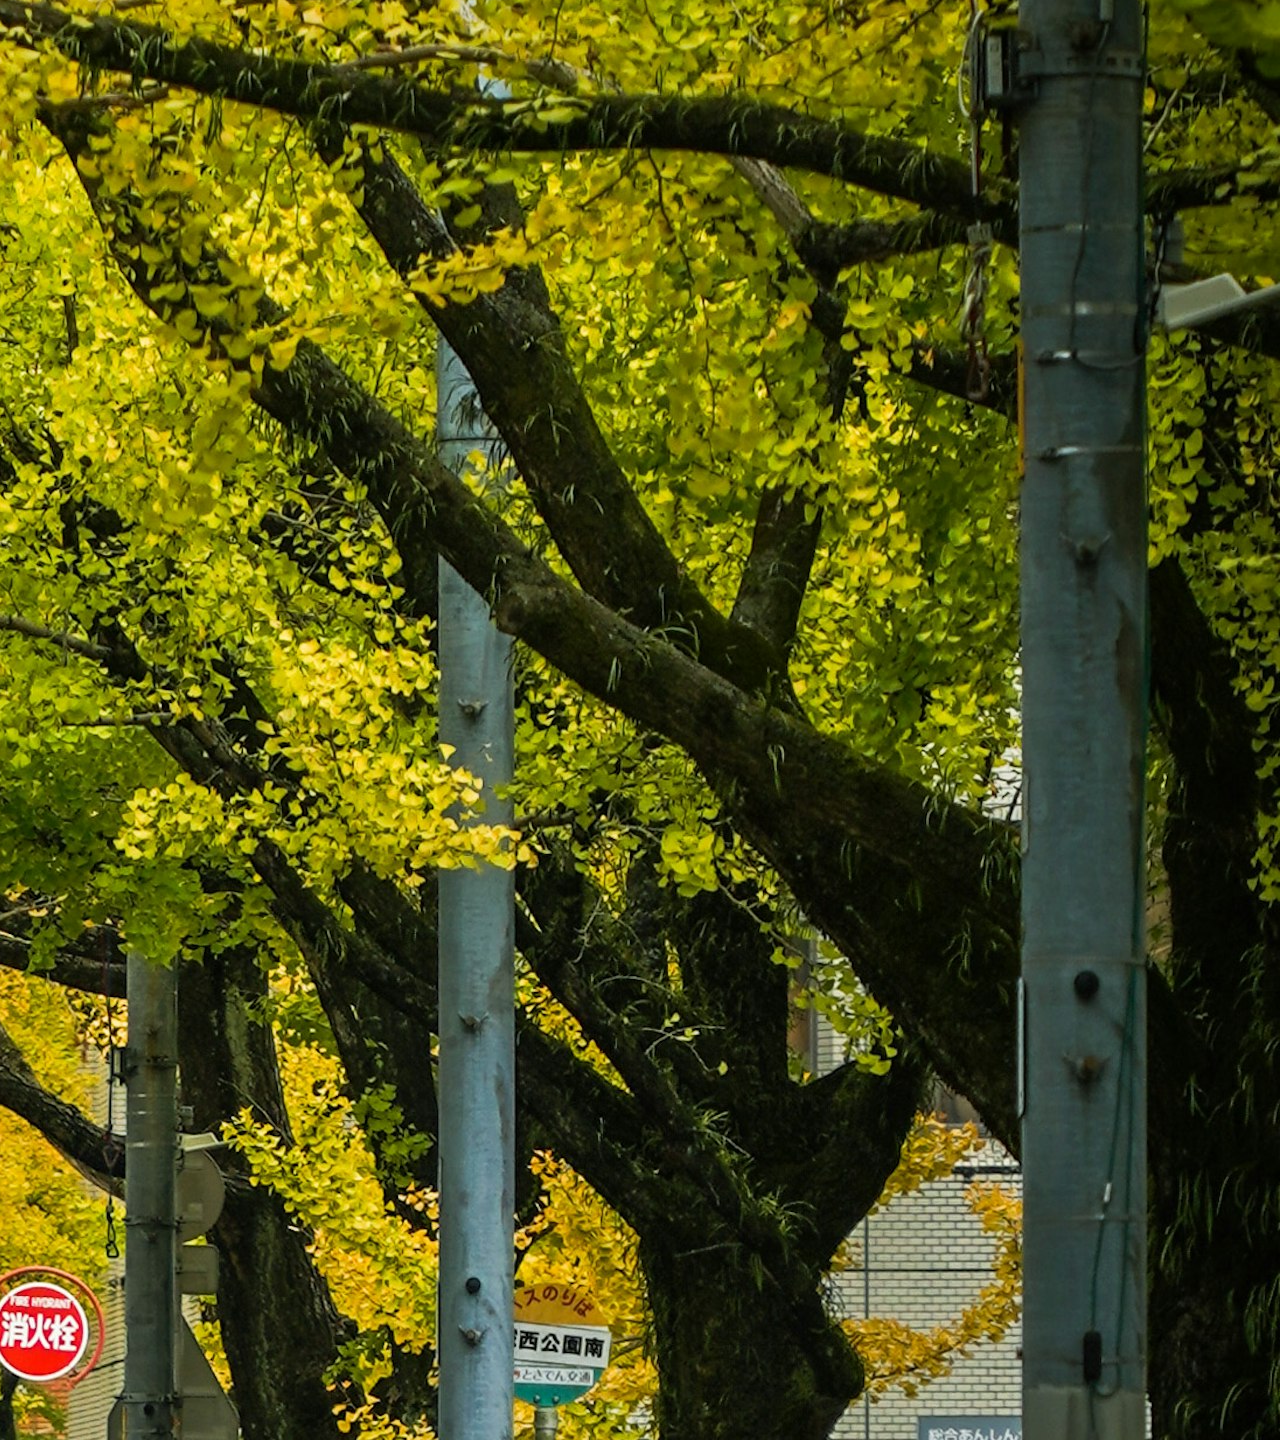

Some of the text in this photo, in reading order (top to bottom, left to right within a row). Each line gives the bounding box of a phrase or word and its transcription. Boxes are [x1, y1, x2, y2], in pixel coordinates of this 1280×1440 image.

[9, 1296, 72, 1310] FIRE HYDRANT
[0, 1311, 79, 1352] 消火栓
[514, 1328, 605, 1359] 西公園南
